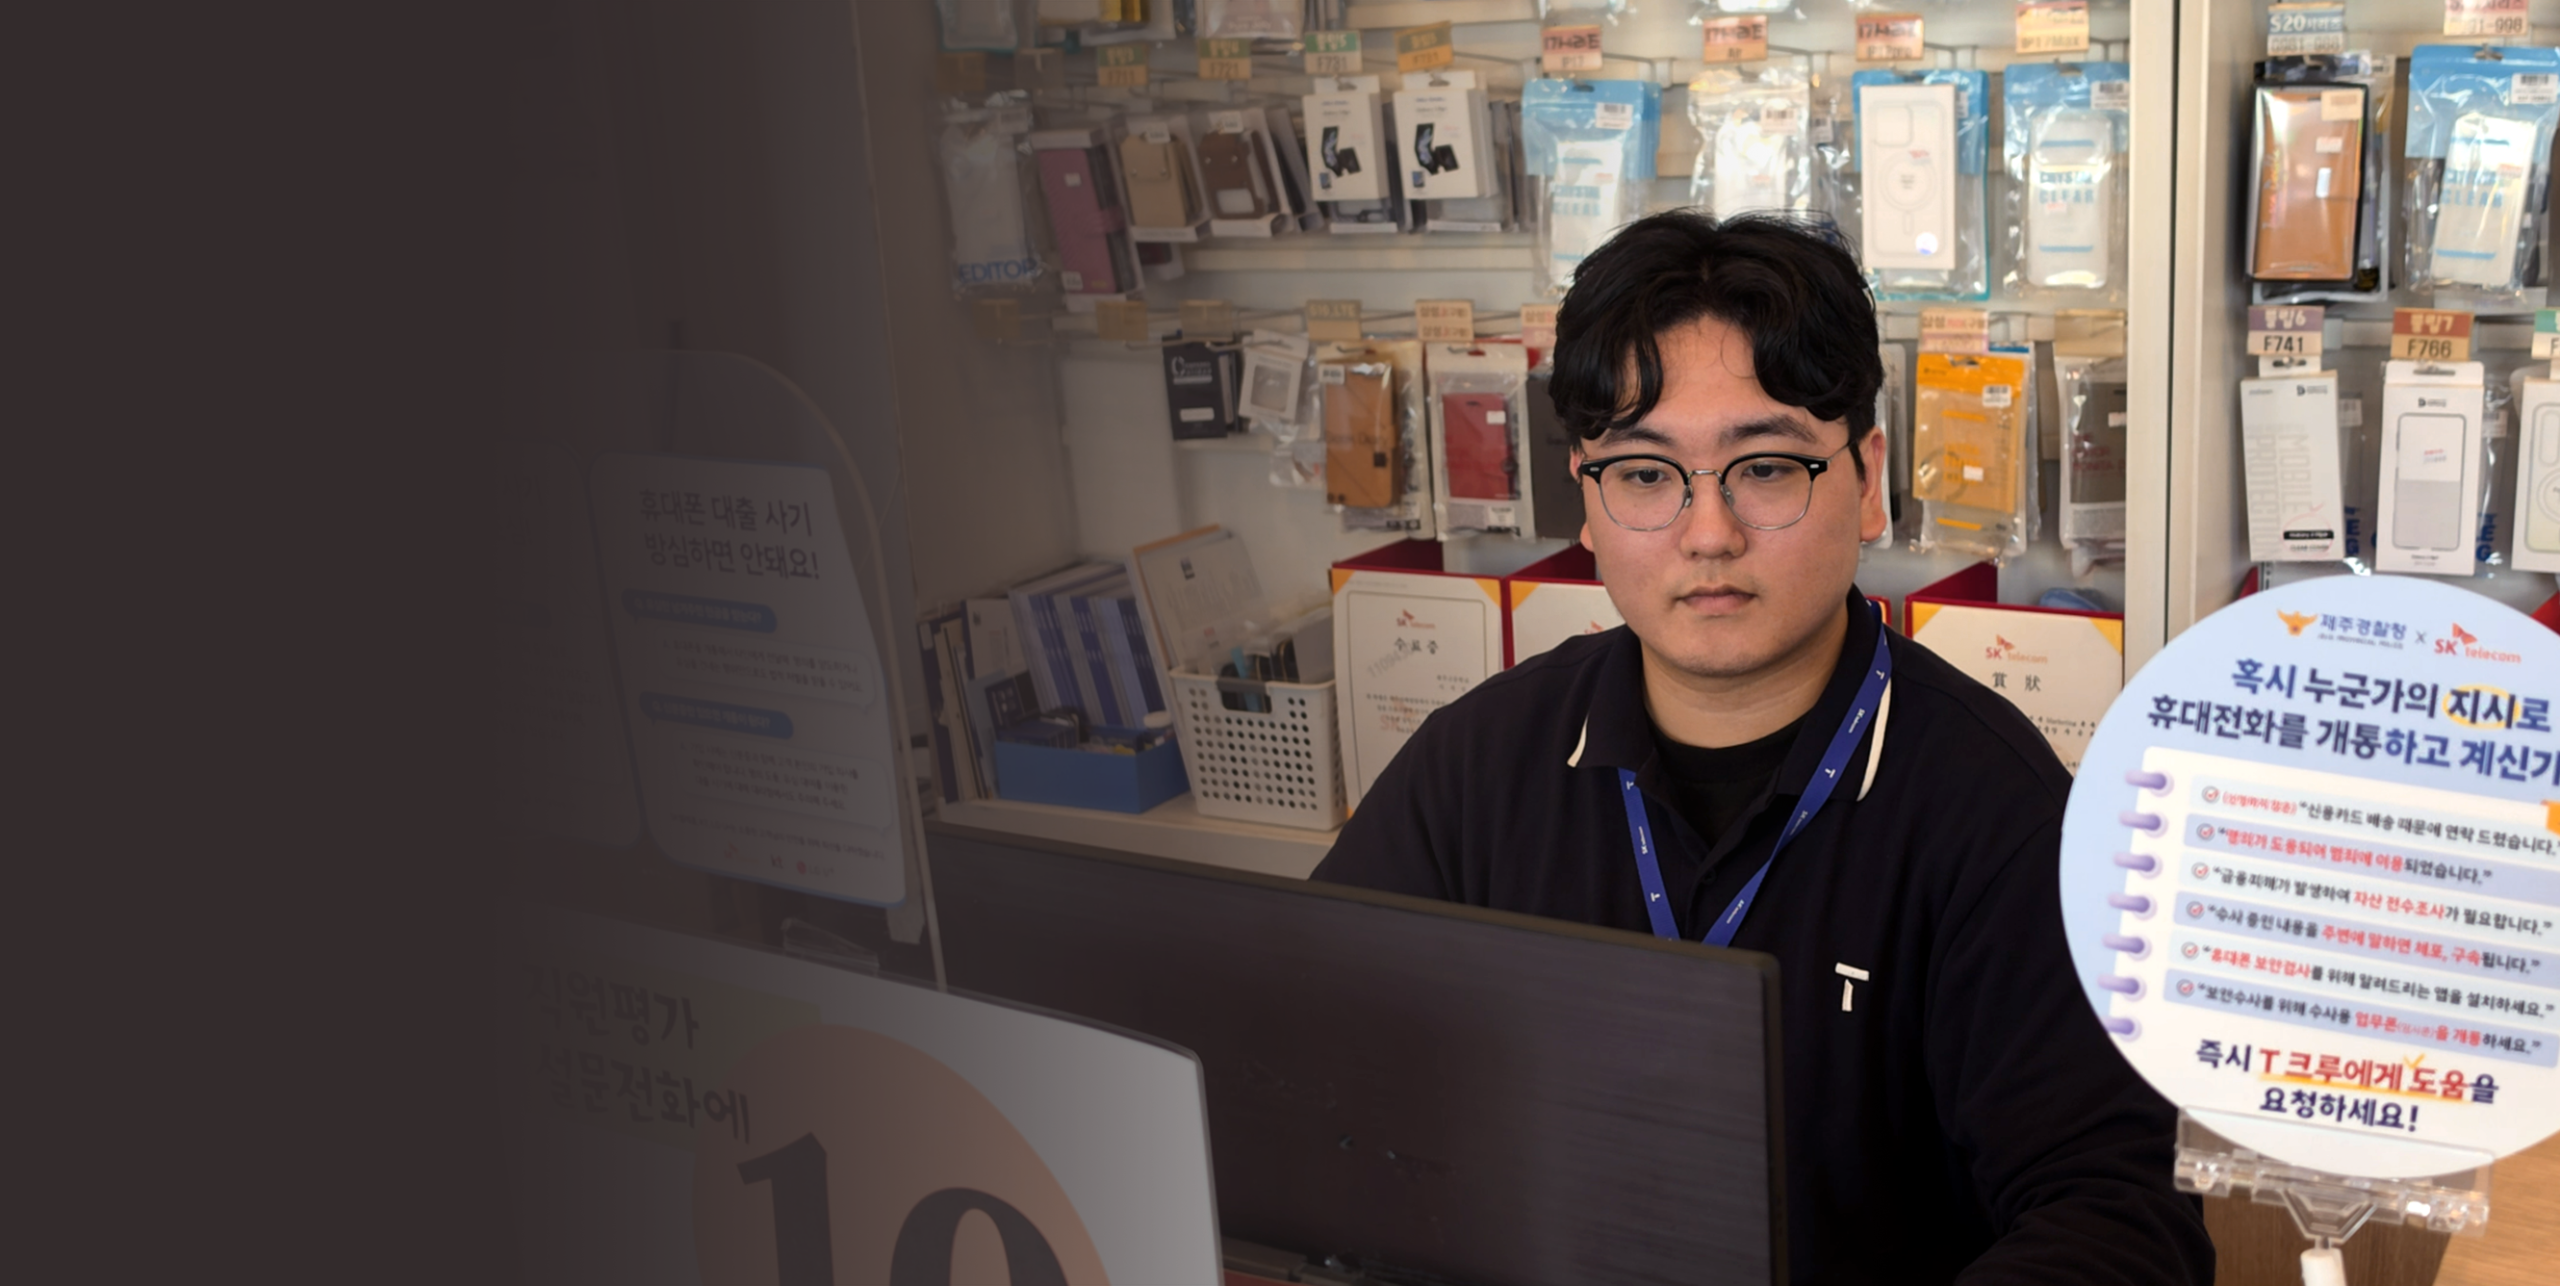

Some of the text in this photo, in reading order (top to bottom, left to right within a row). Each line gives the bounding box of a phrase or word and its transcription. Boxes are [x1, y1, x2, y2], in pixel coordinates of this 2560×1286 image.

[2263, 335, 2304, 353] F741
[2407, 339, 2452, 357] F766
[639, 488, 812, 537] 휴대폰 대출 사기
[644, 532, 820, 580] 방심하면 안돼요!
[1986, 648, 2048, 664] SK telecom
[2320, 613, 2522, 664] 제주경찰청 SK telecom
[2232, 657, 2552, 732] 혹시 누군가의 지시로
[2147, 695, 2309, 749] 휴대전화를
[2316, 720, 2451, 768] 개통하고
[1824, 768, 1836, 779] T
[2366, 812, 2394, 831] 배송
[2397, 816, 2442, 838] 때문에
[2445, 823, 2474, 842] 연락
[1650, 892, 1661, 902] T
[2353, 890, 2382, 910] 자산
[2386, 895, 2459, 922] 전수조사가
[2276, 916, 2319, 938] 내용을
[2322, 924, 2365, 946] 주변에
[2368, 932, 2411, 954] 말하면
[2415, 940, 2448, 962] 체포,
[1835, 962, 1870, 1012] T
[2327, 968, 2355, 987] 위해
[2358, 973, 2430, 1000] 알려드리는
[2434, 986, 2462, 1005] 앱을
[2278, 997, 2306, 1016] 위해
[2309, 1004, 2351, 1025] 수사용
[2196, 1038, 2499, 1104] 즉시 T 크루에게 도움을
[2259, 1086, 2420, 1132] 요청하세요!
[736, 1131, 1070, 1286] 10
